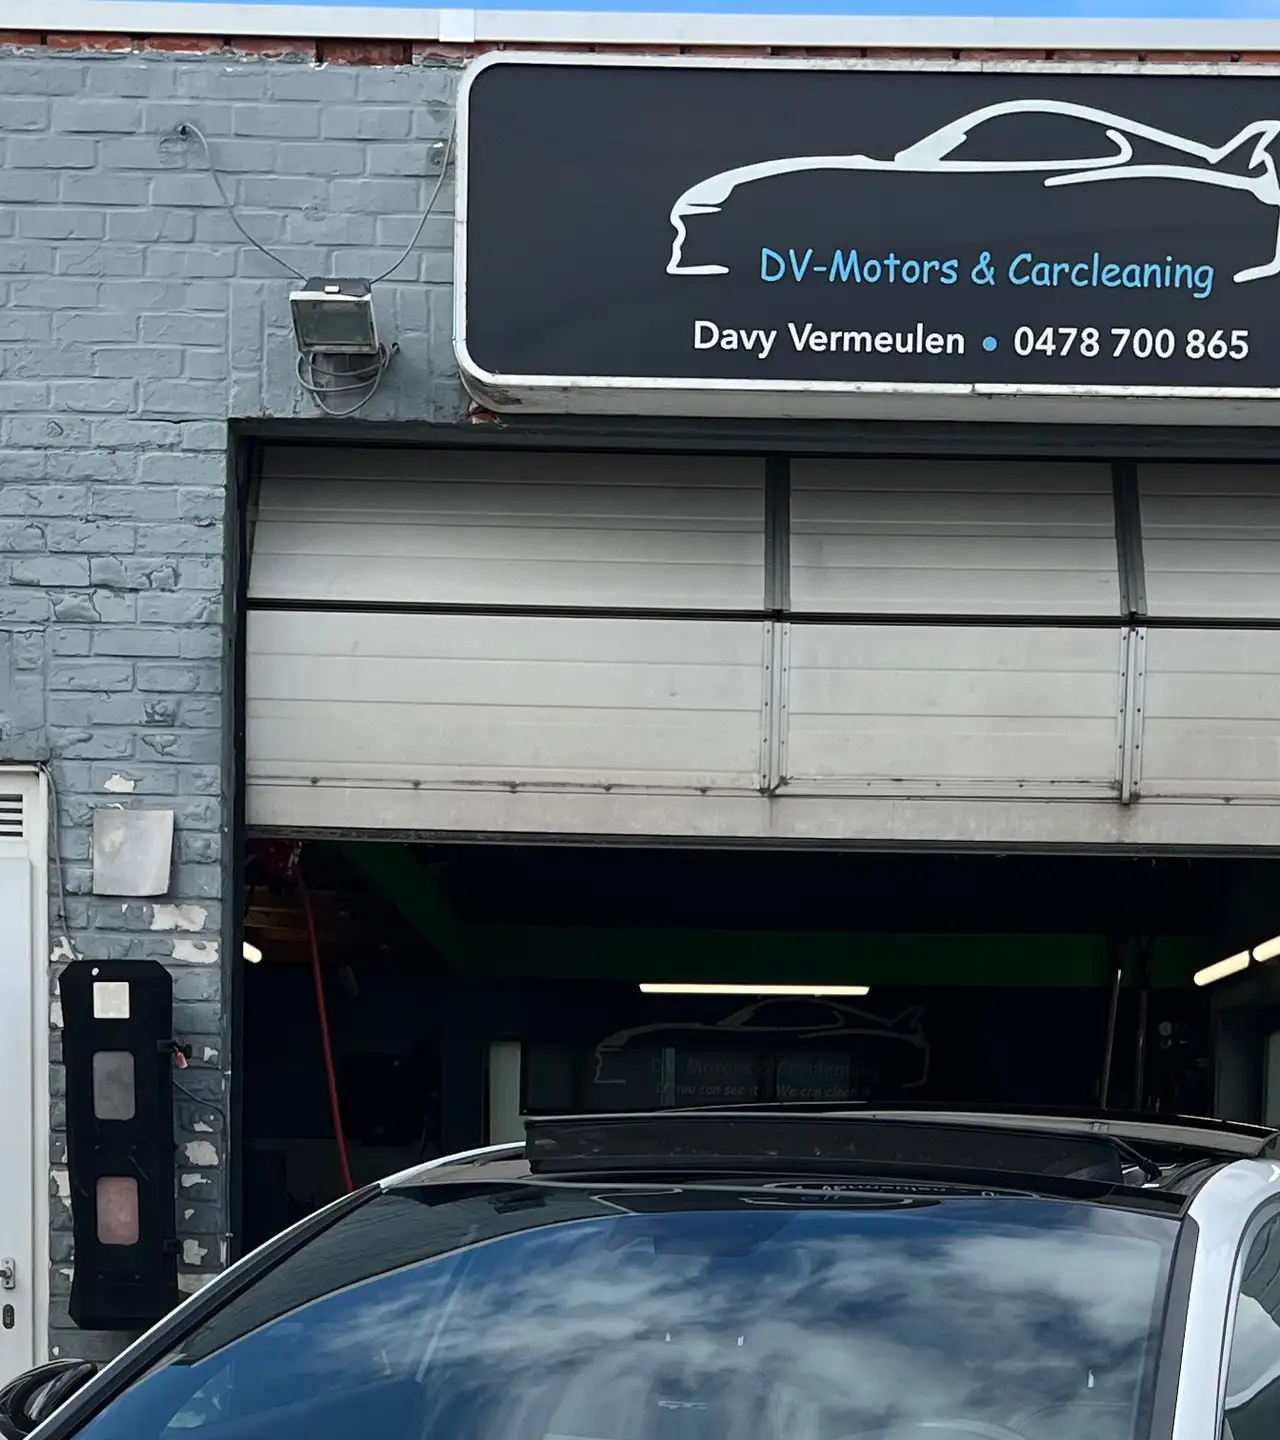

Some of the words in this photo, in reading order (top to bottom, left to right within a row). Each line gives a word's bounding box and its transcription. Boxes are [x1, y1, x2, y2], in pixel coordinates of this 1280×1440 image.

[760, 247, 959, 286] DV-Motors
[971, 251, 995, 286] &
[1008, 252, 1215, 299] Carcleaning
[694, 320, 778, 359] Davy
[787, 322, 965, 354] Vermeulen
[1014, 326, 1100, 357] 0478
[1111, 328, 1175, 359] 700
[1185, 329, 1249, 360] 865
